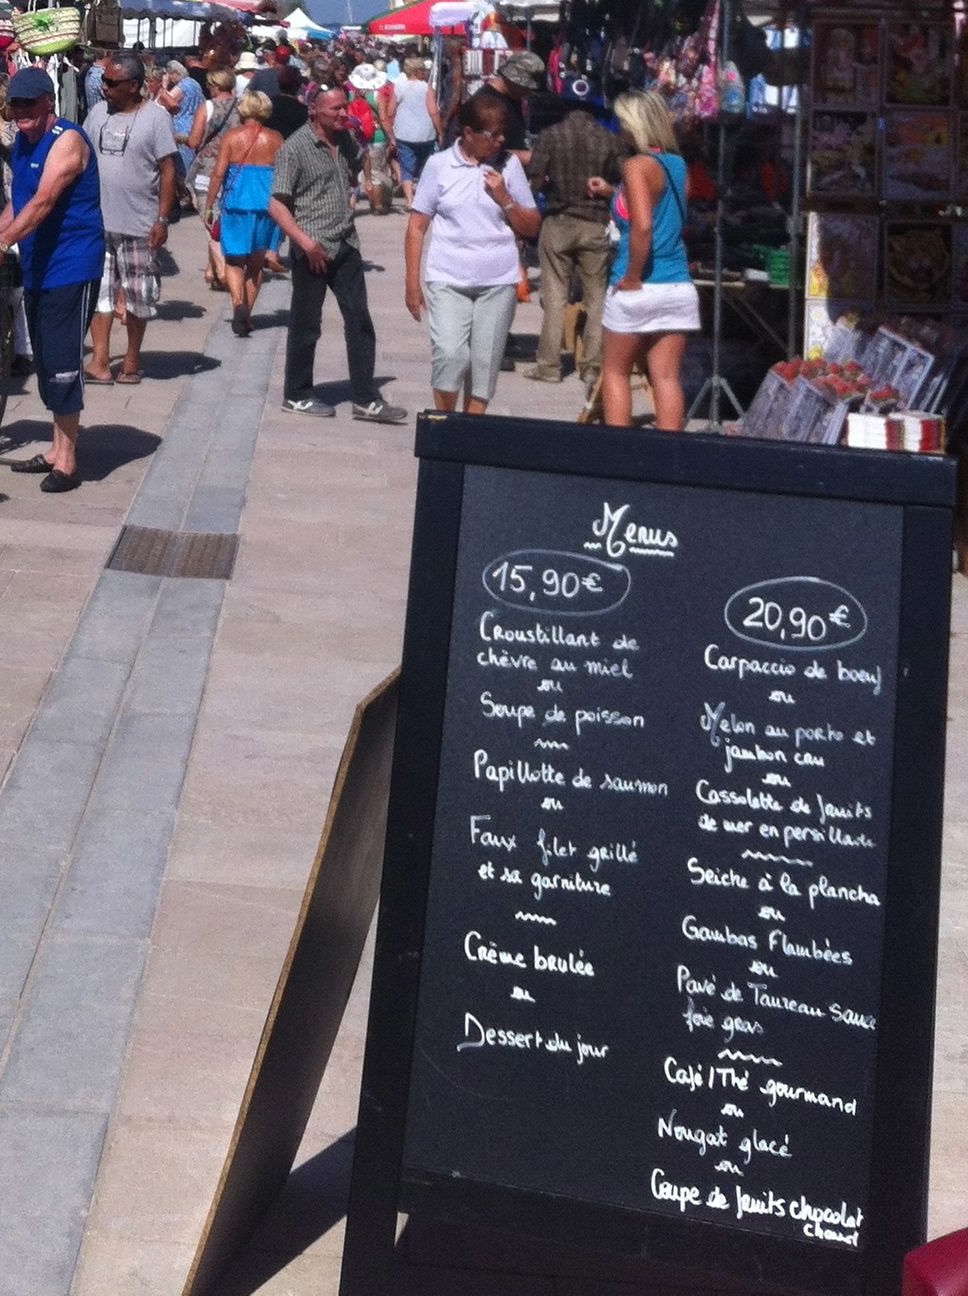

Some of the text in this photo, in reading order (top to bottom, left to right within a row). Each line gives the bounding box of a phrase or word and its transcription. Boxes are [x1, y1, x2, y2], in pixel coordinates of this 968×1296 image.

[592, 502, 678, 557] Menus
[612, 634, 640, 651] de
[551, 658, 577, 672] au
[584, 659, 633, 679] miel
[704, 645, 795, 679] Carpaccio
[804, 660, 827, 679] de
[537, 679, 563, 693] ou
[769, 690, 795, 704] ou
[480, 692, 644, 734] Soupe de poisson
[765, 725, 789, 738] au
[855, 730, 876, 746] et
[474, 749, 668, 796] Papillotte de saumon
[725, 738, 787, 773] jambon
[696, 779, 784, 812] Cassolette
[790, 796, 811, 814] de
[762, 774, 791, 787] ou
[541, 798, 564, 811] ou
[699, 814, 718, 832] de
[724, 819, 753, 834] mer
[759, 823, 779, 838] en
[470, 815, 637, 872] Faux filet grillé
[478, 863, 611, 900] et sa garniture
[687, 857, 881, 909] Seiche à la plancha
[758, 906, 786, 922] ou
[682, 915, 758, 949] Gambas
[749, 961, 778, 977] ou
[510, 986, 535, 1003] ou
[677, 965, 716, 996] Pavé
[721, 982, 743, 1002] de
[747, 983, 825, 1017] Taureau
[457, 1012, 609, 1064] Dessert du jour
[722, 1016, 763, 1041] gras
[721, 1103, 744, 1118] ou
[760, 1079, 856, 1116] gourmand
[658, 1109, 792, 1163] Nougat glacé
[714, 1160, 743, 1175] ou
[651, 1168, 701, 1212] Coupe
[706, 1187, 729, 1209] de
[789, 1195, 864, 1228] chocolat
